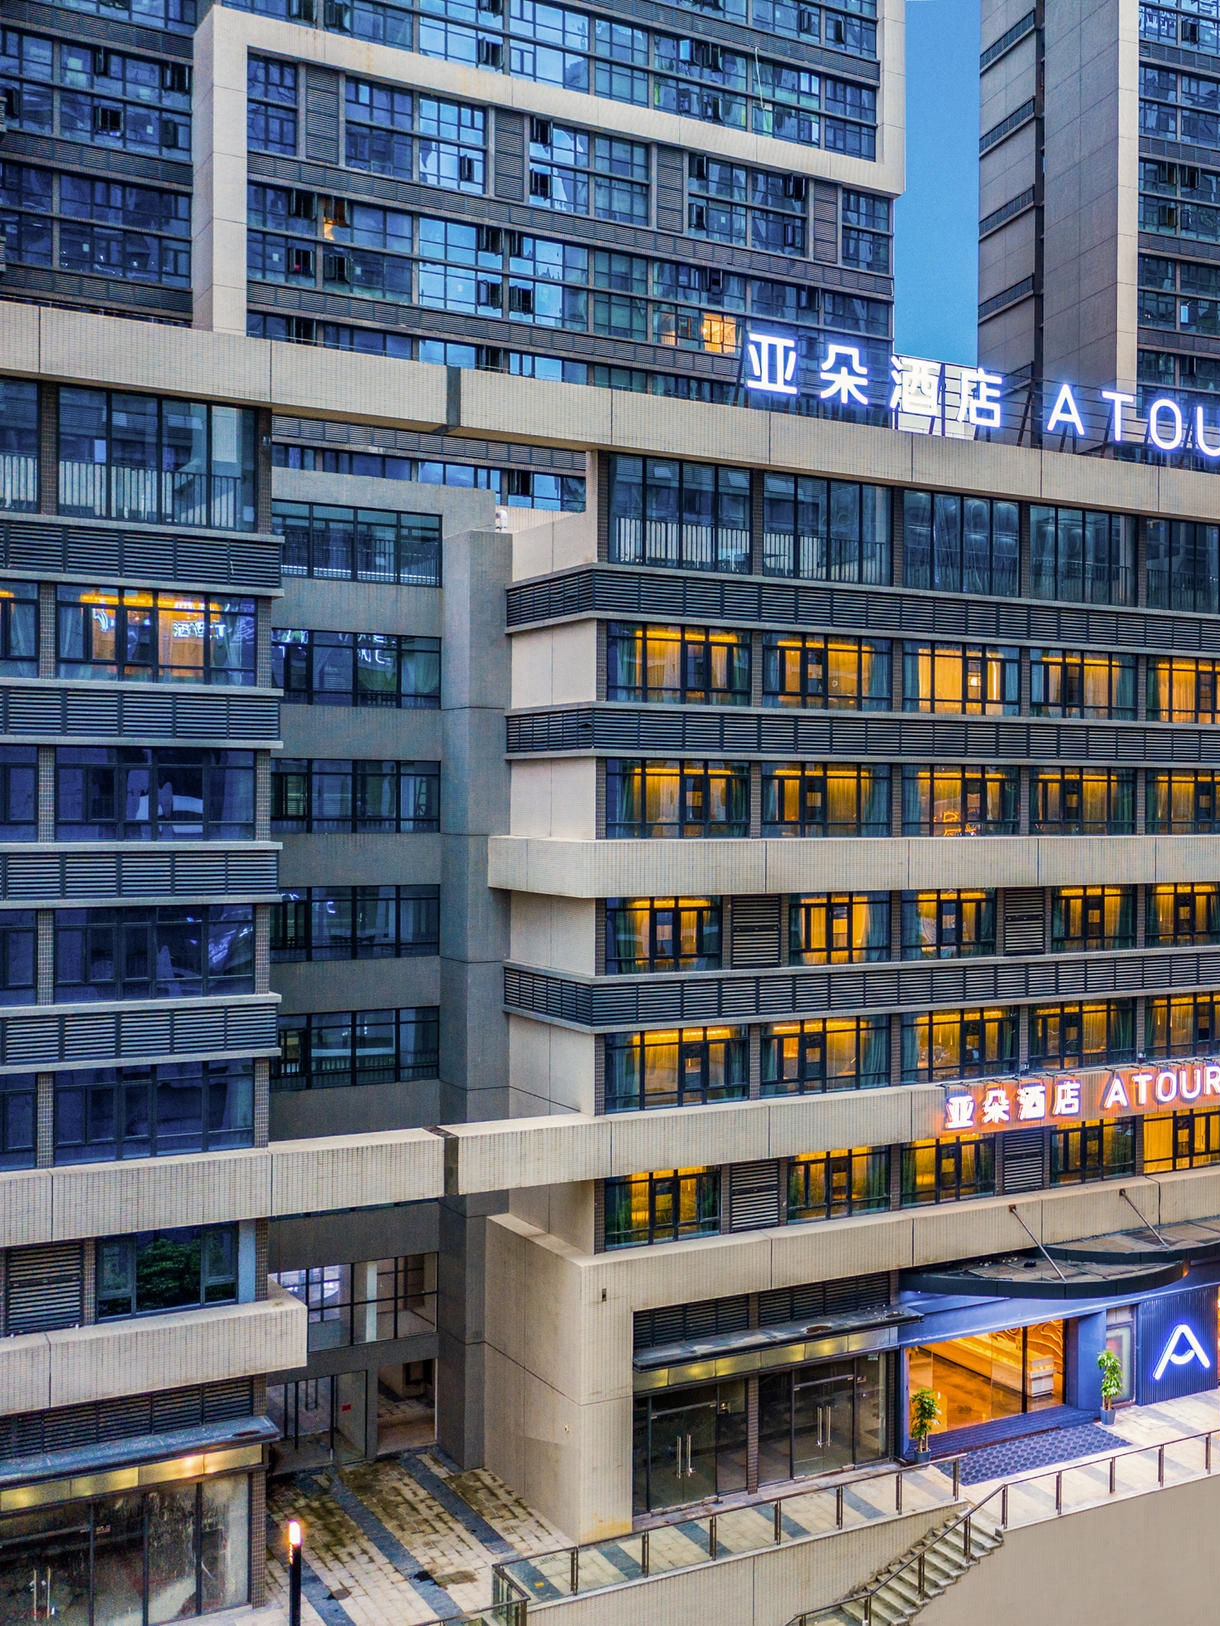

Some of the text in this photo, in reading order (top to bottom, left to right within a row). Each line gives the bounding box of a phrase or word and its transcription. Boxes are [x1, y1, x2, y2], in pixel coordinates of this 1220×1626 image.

[747, 333, 1002, 428] 亚朵酒店
[946, 1080, 1081, 1129] 亚朵酒店
